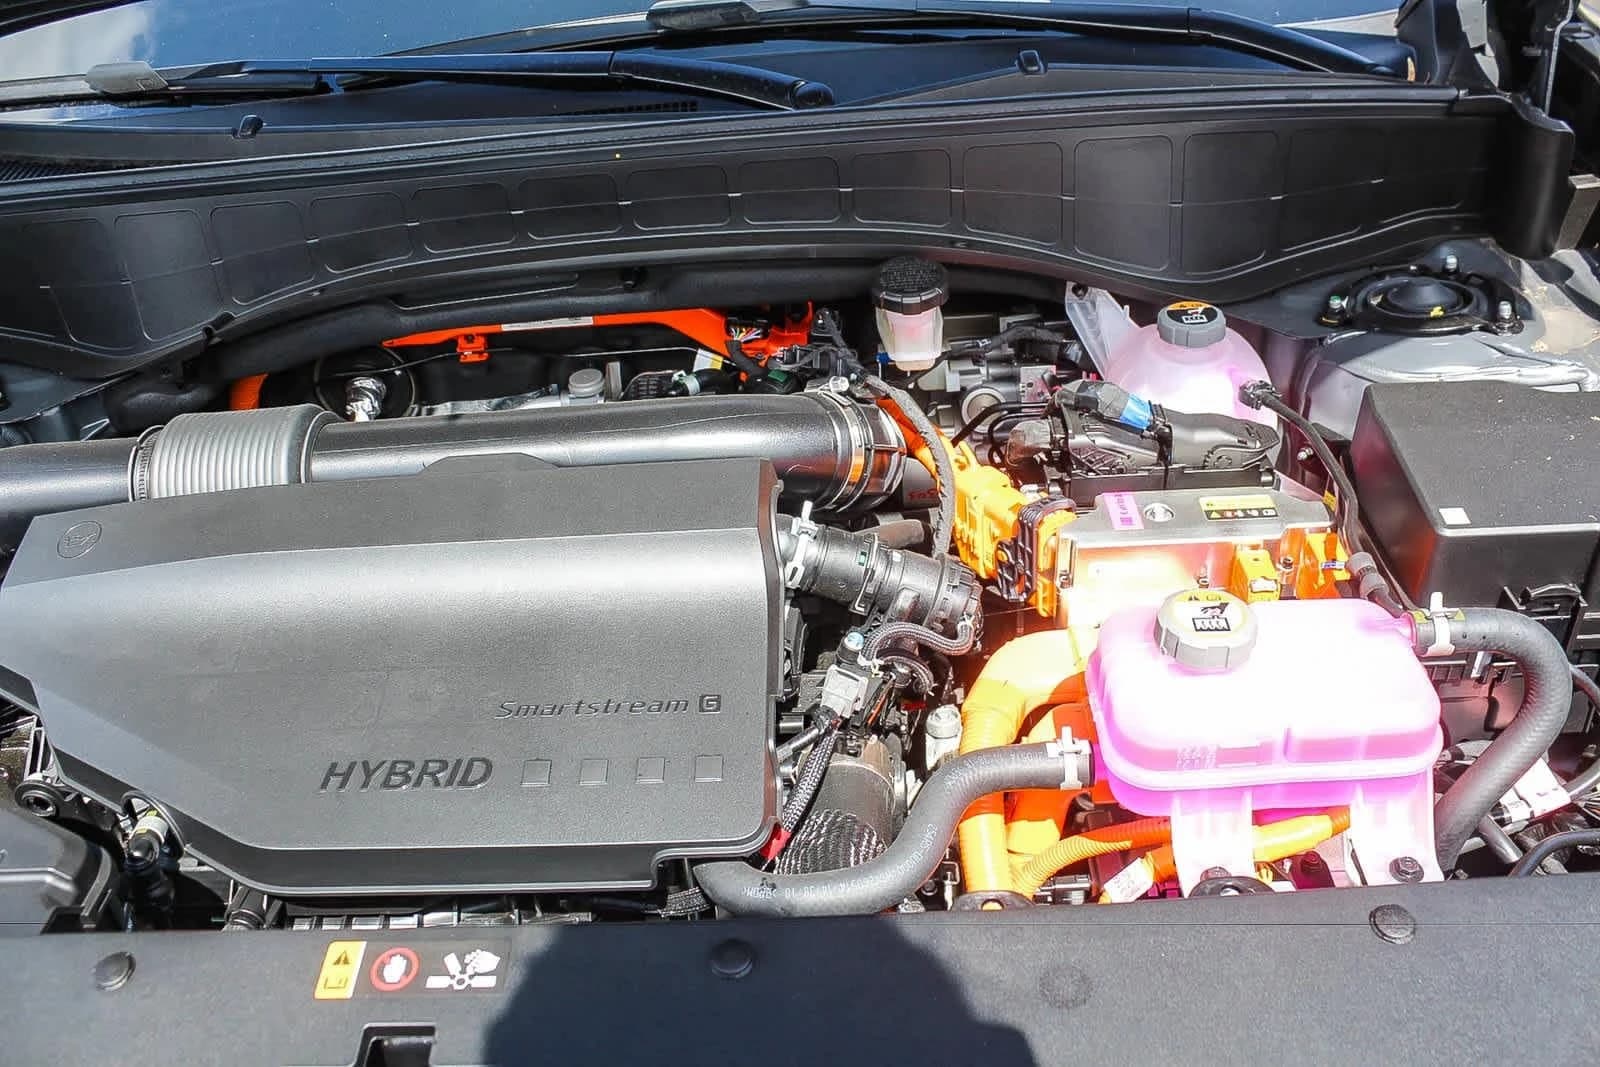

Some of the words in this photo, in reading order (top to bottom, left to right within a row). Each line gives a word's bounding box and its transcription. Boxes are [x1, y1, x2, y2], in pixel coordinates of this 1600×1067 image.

[496, 698, 689, 719] Smartstream
[700, 695, 721, 713] G
[318, 757, 494, 792] HYBRID
